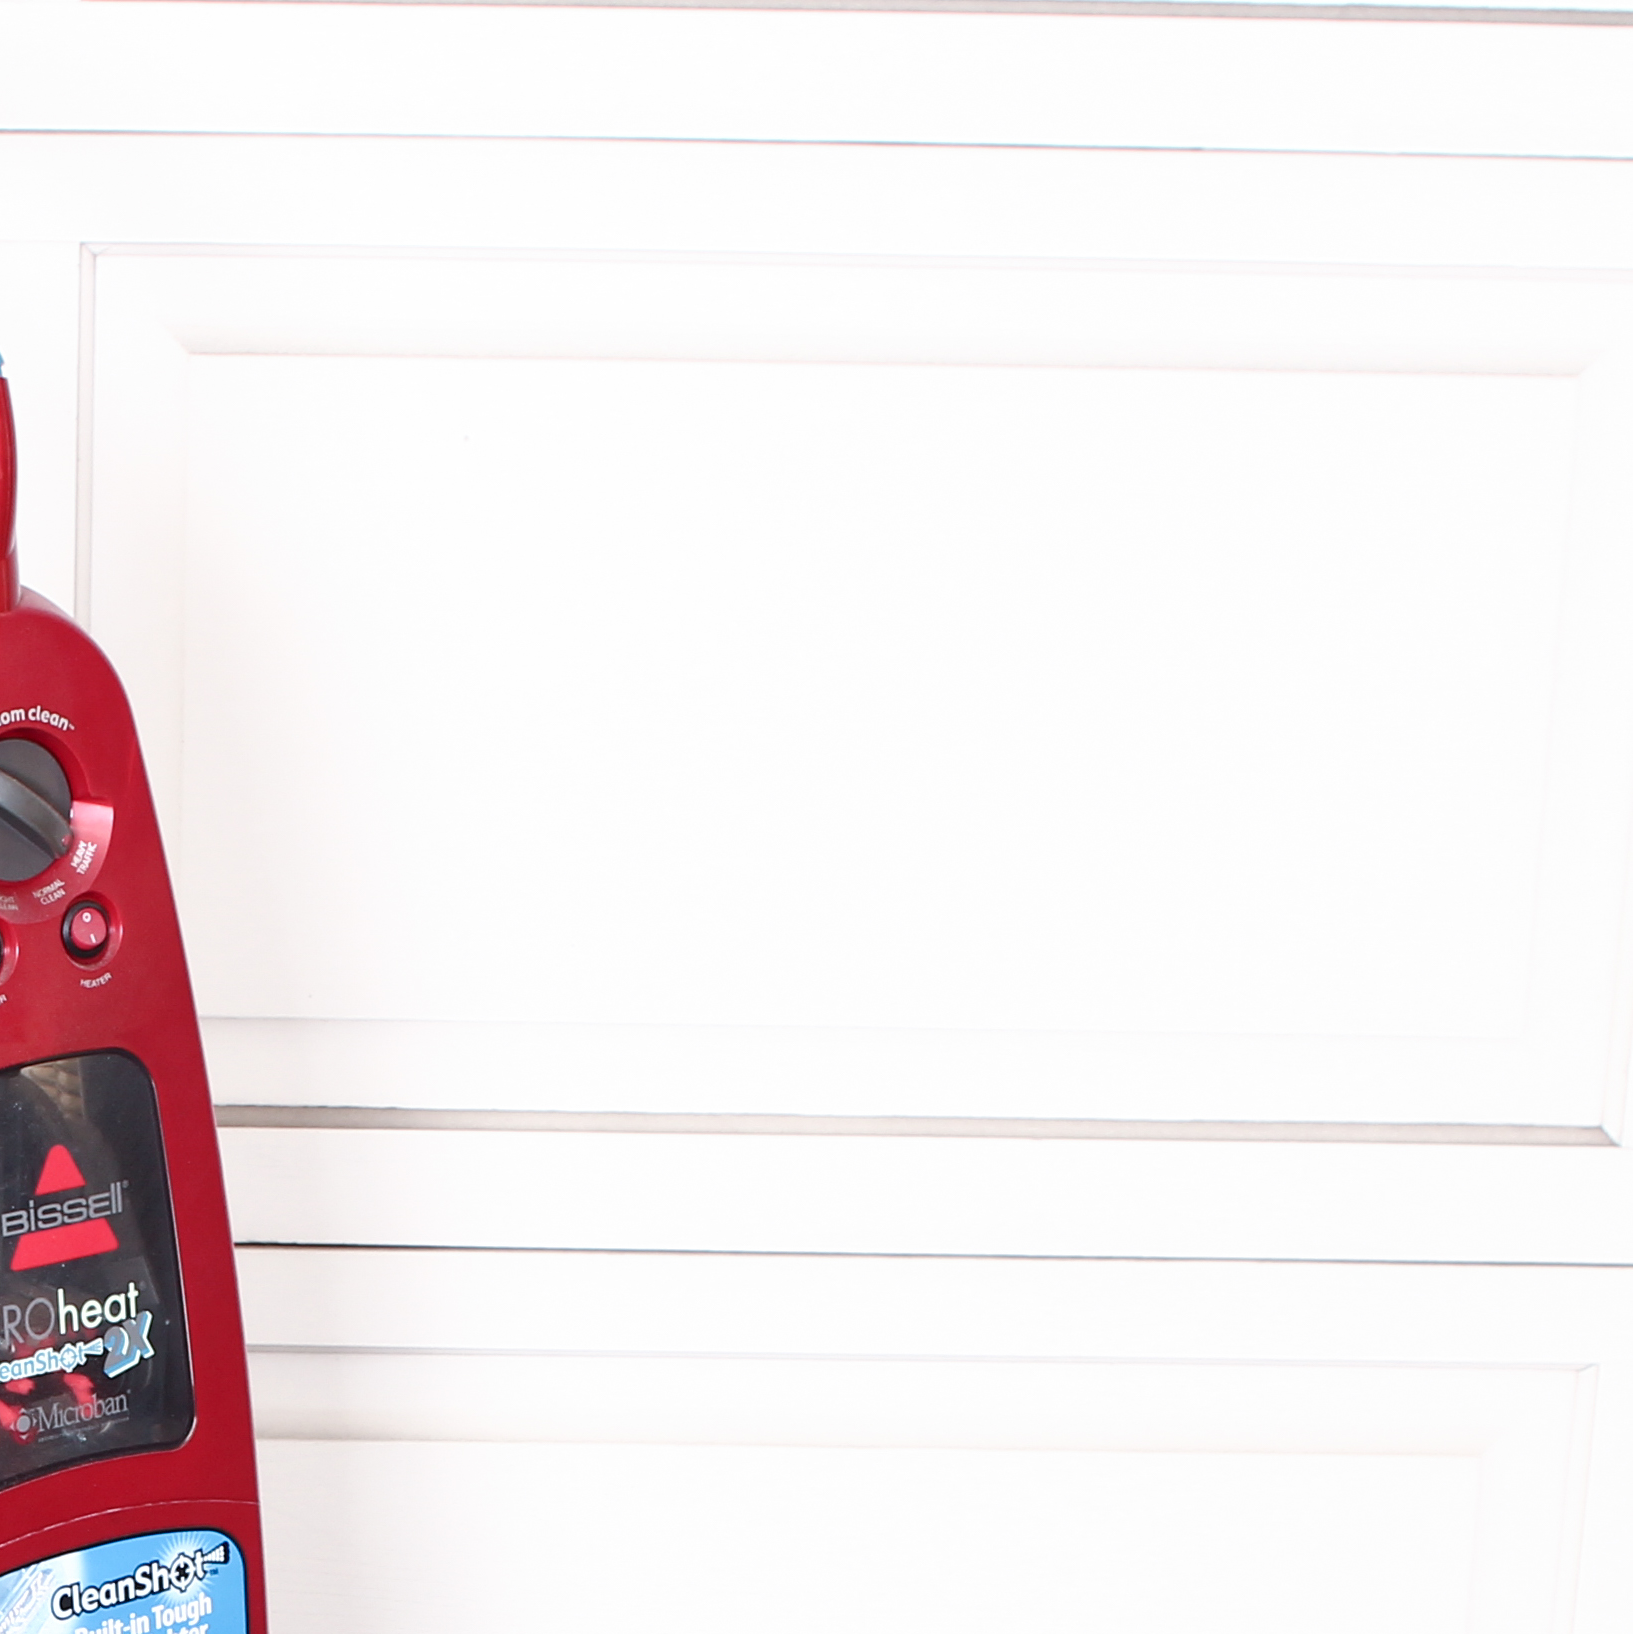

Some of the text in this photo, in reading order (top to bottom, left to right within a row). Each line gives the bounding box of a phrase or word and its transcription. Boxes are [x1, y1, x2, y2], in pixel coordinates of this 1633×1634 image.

[80, 972, 112, 988] HEATER
[38, 1392, 129, 1432] Microban
[151, 1594, 212, 1632] Tough
